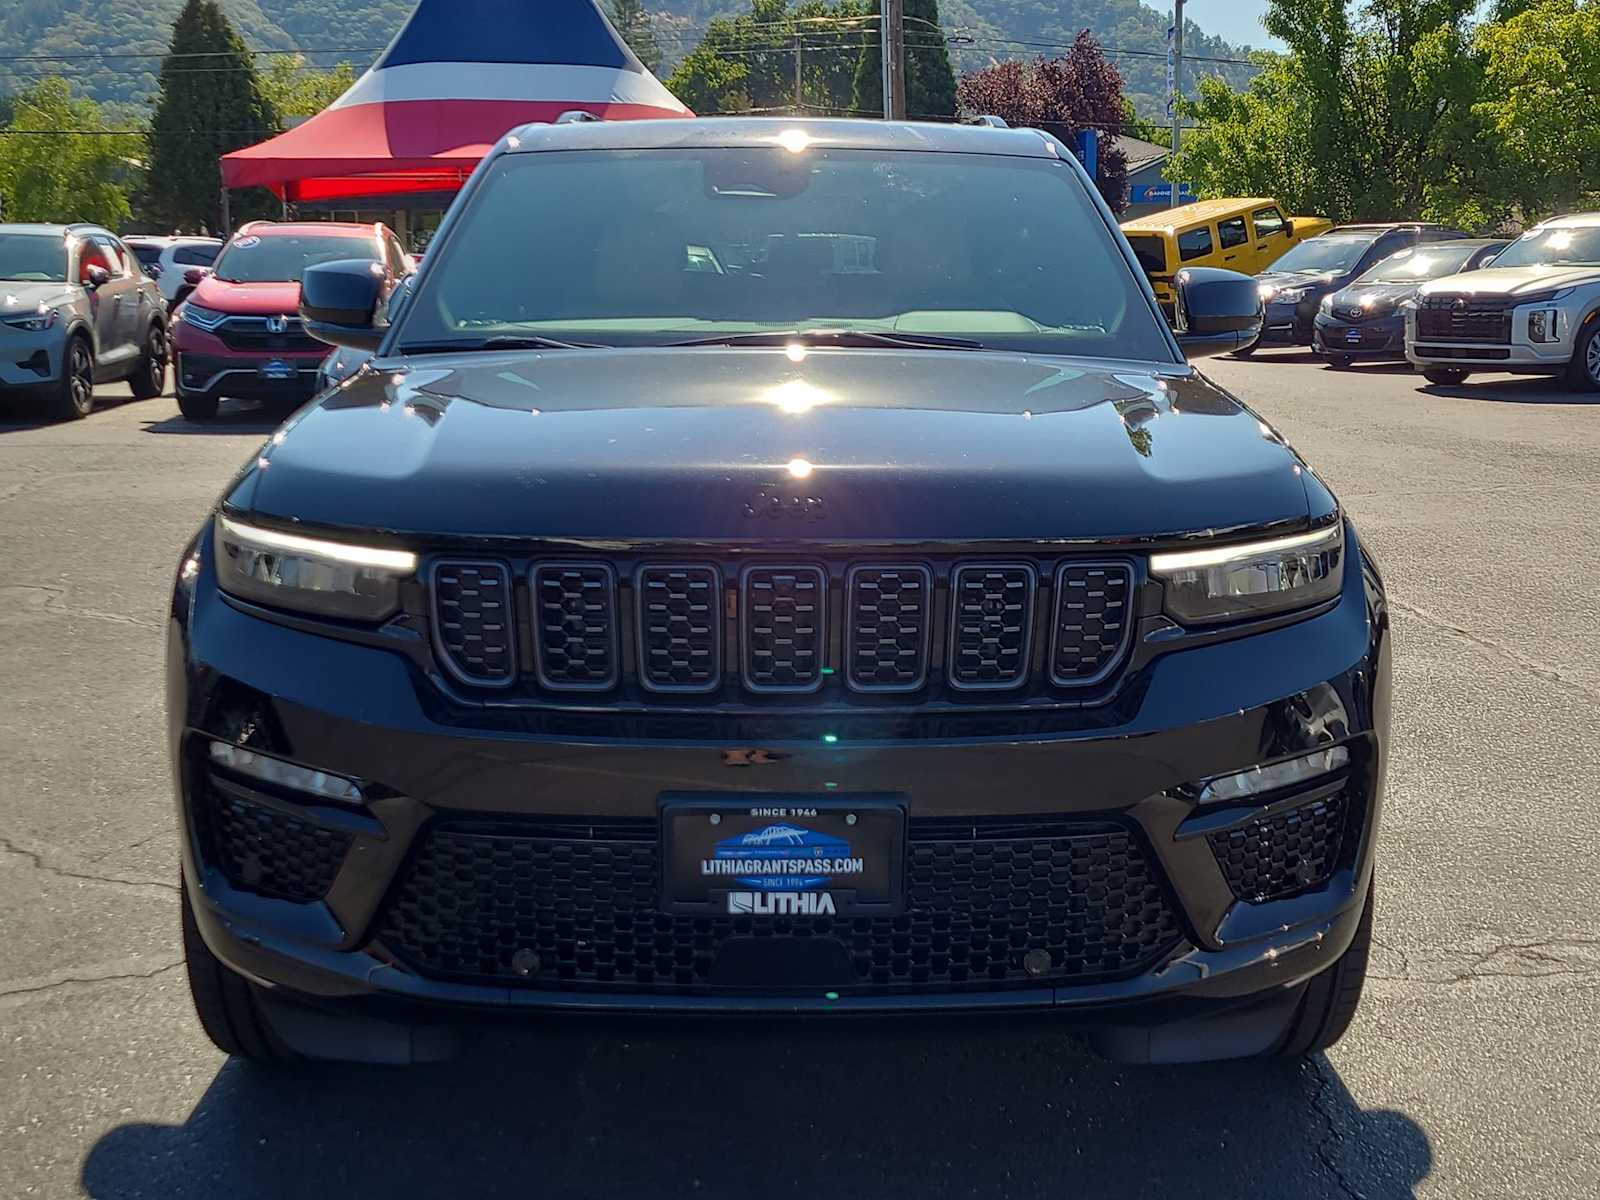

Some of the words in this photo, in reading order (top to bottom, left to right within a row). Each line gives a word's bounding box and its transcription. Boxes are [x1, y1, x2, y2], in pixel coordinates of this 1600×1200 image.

[751, 808, 787, 817] SINCE
[791, 808, 817, 817] 1946
[701, 858, 864, 875] LITHIAGRANTSPASS.COM
[753, 892, 836, 914] LITHIA
